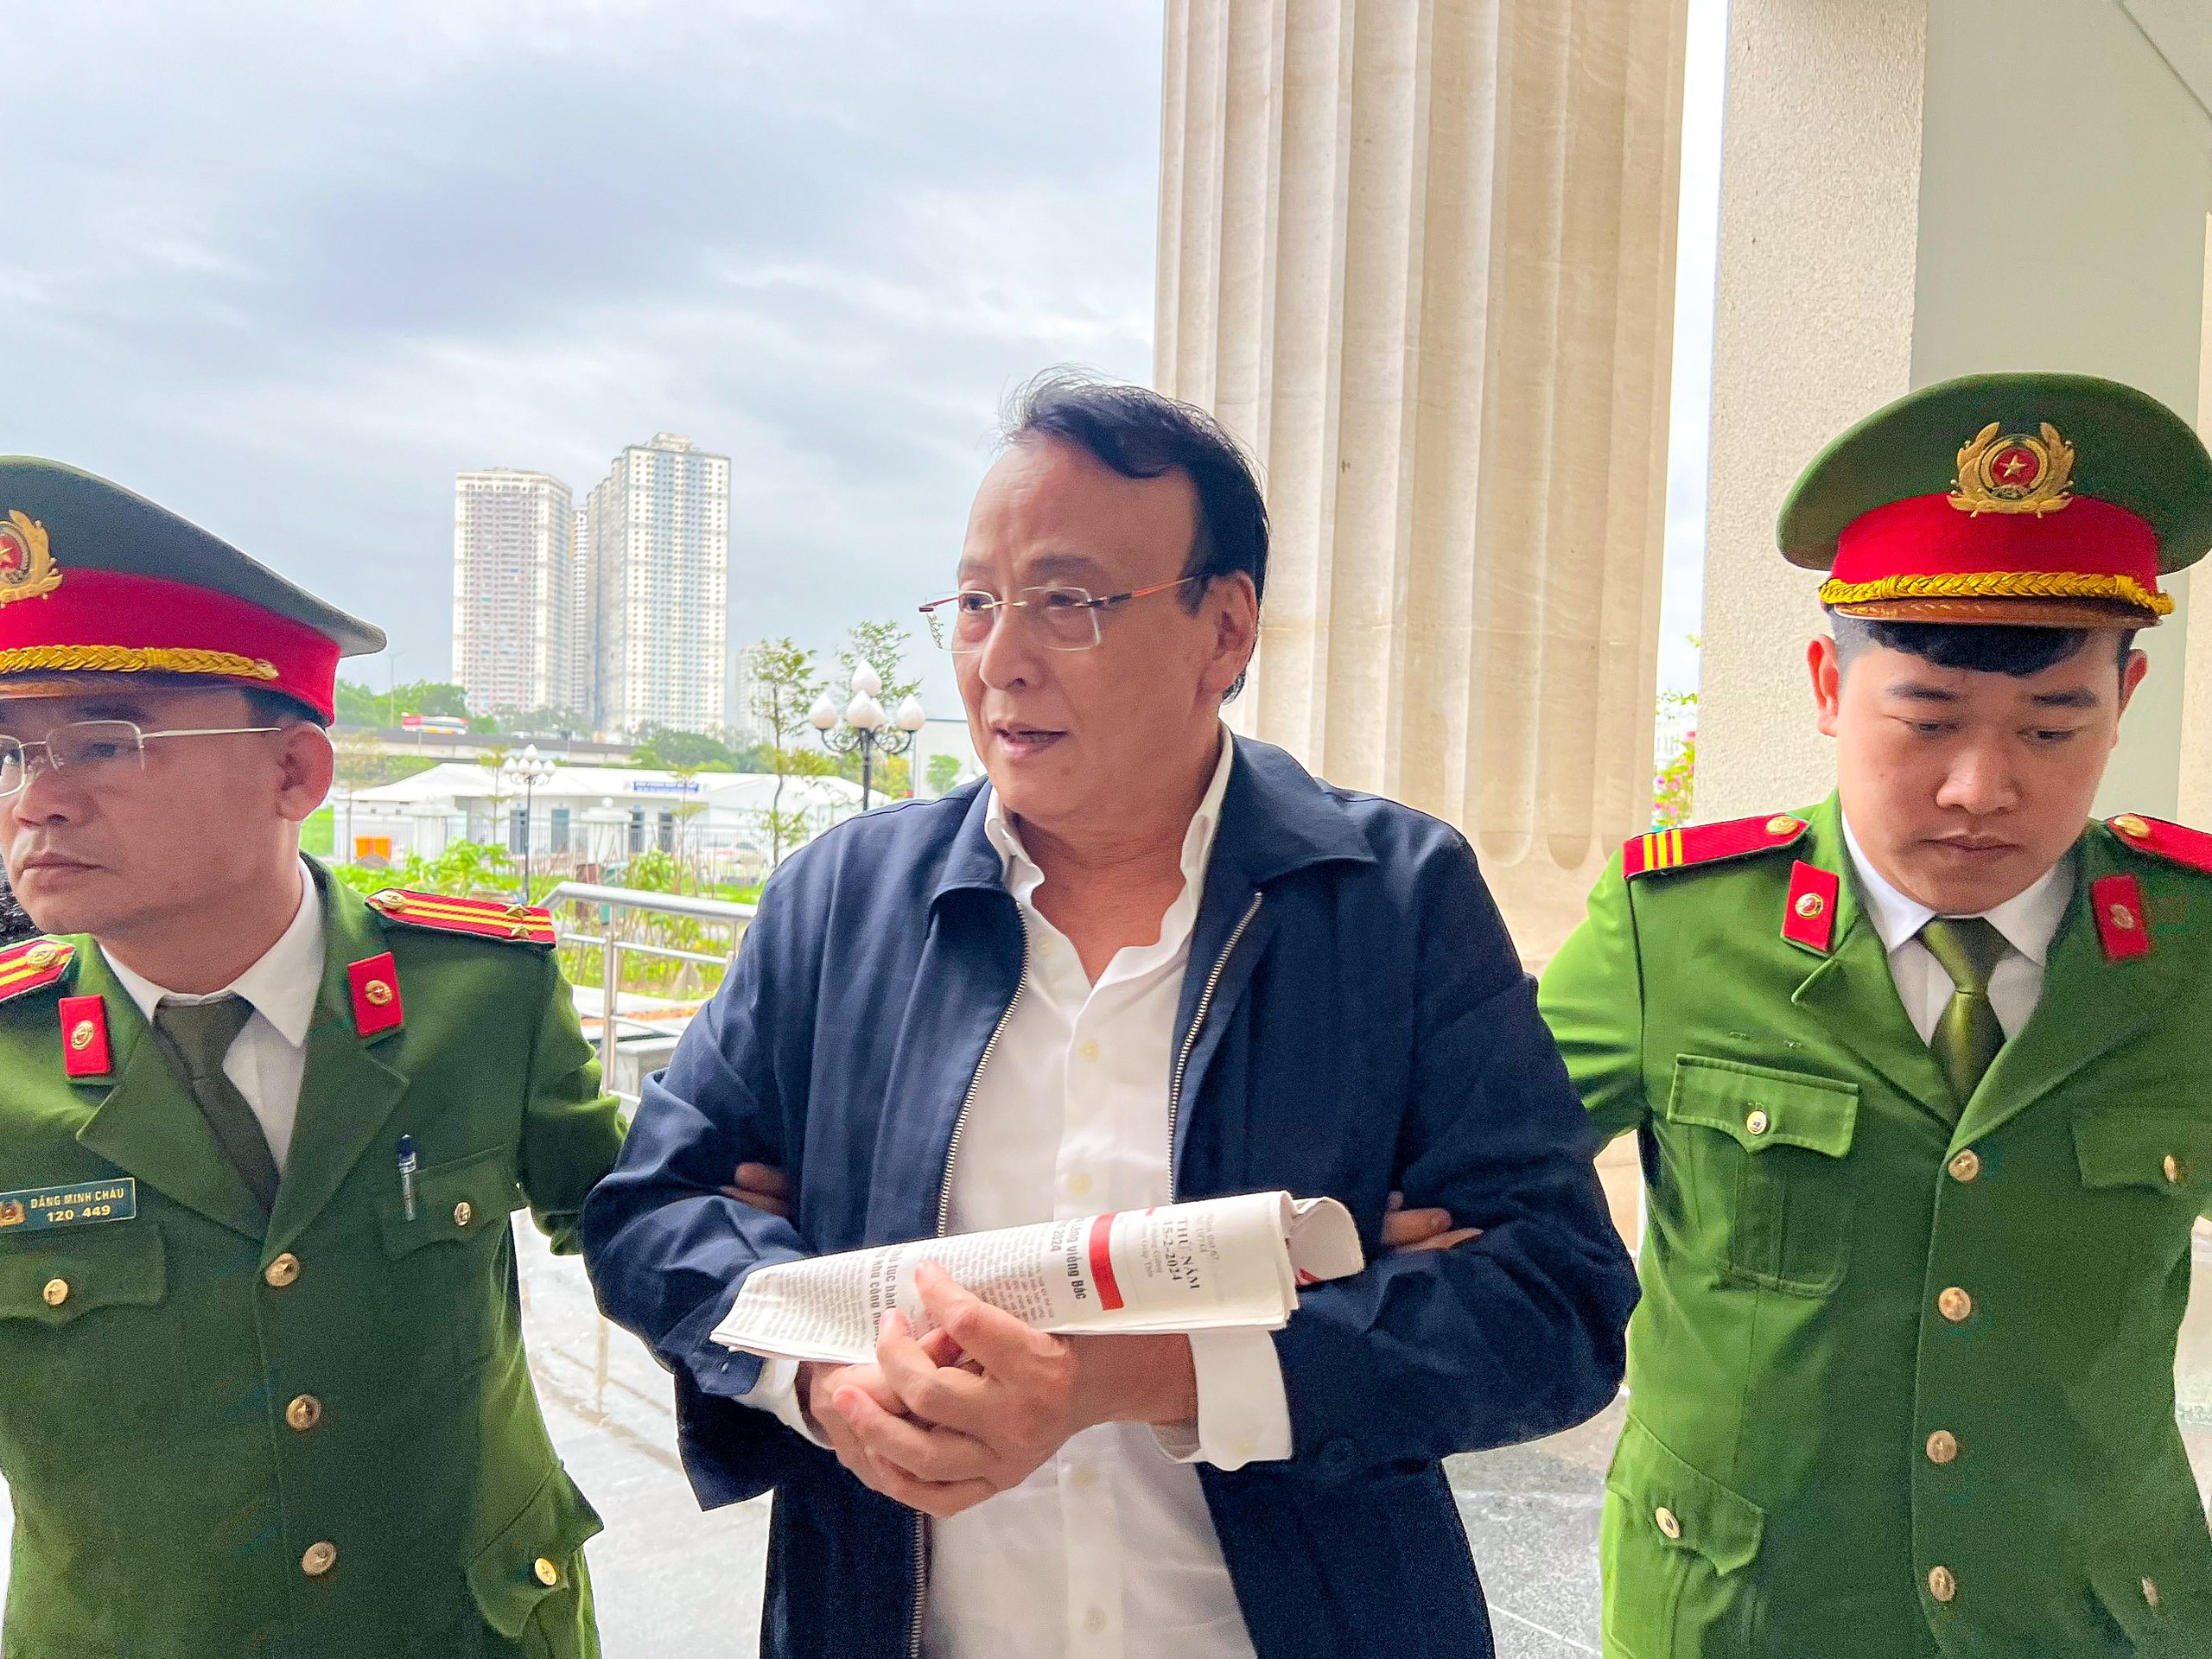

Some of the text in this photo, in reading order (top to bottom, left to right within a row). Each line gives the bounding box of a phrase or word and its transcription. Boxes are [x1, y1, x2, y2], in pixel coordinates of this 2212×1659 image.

[64, 1192, 92, 1205] MINH
[48, 1205, 111, 1223] 120 449
[1162, 1221, 1183, 1280] 15-2-2024
[1181, 1255, 1200, 1289] NĂM
[1071, 1280, 1087, 1300] Bác
